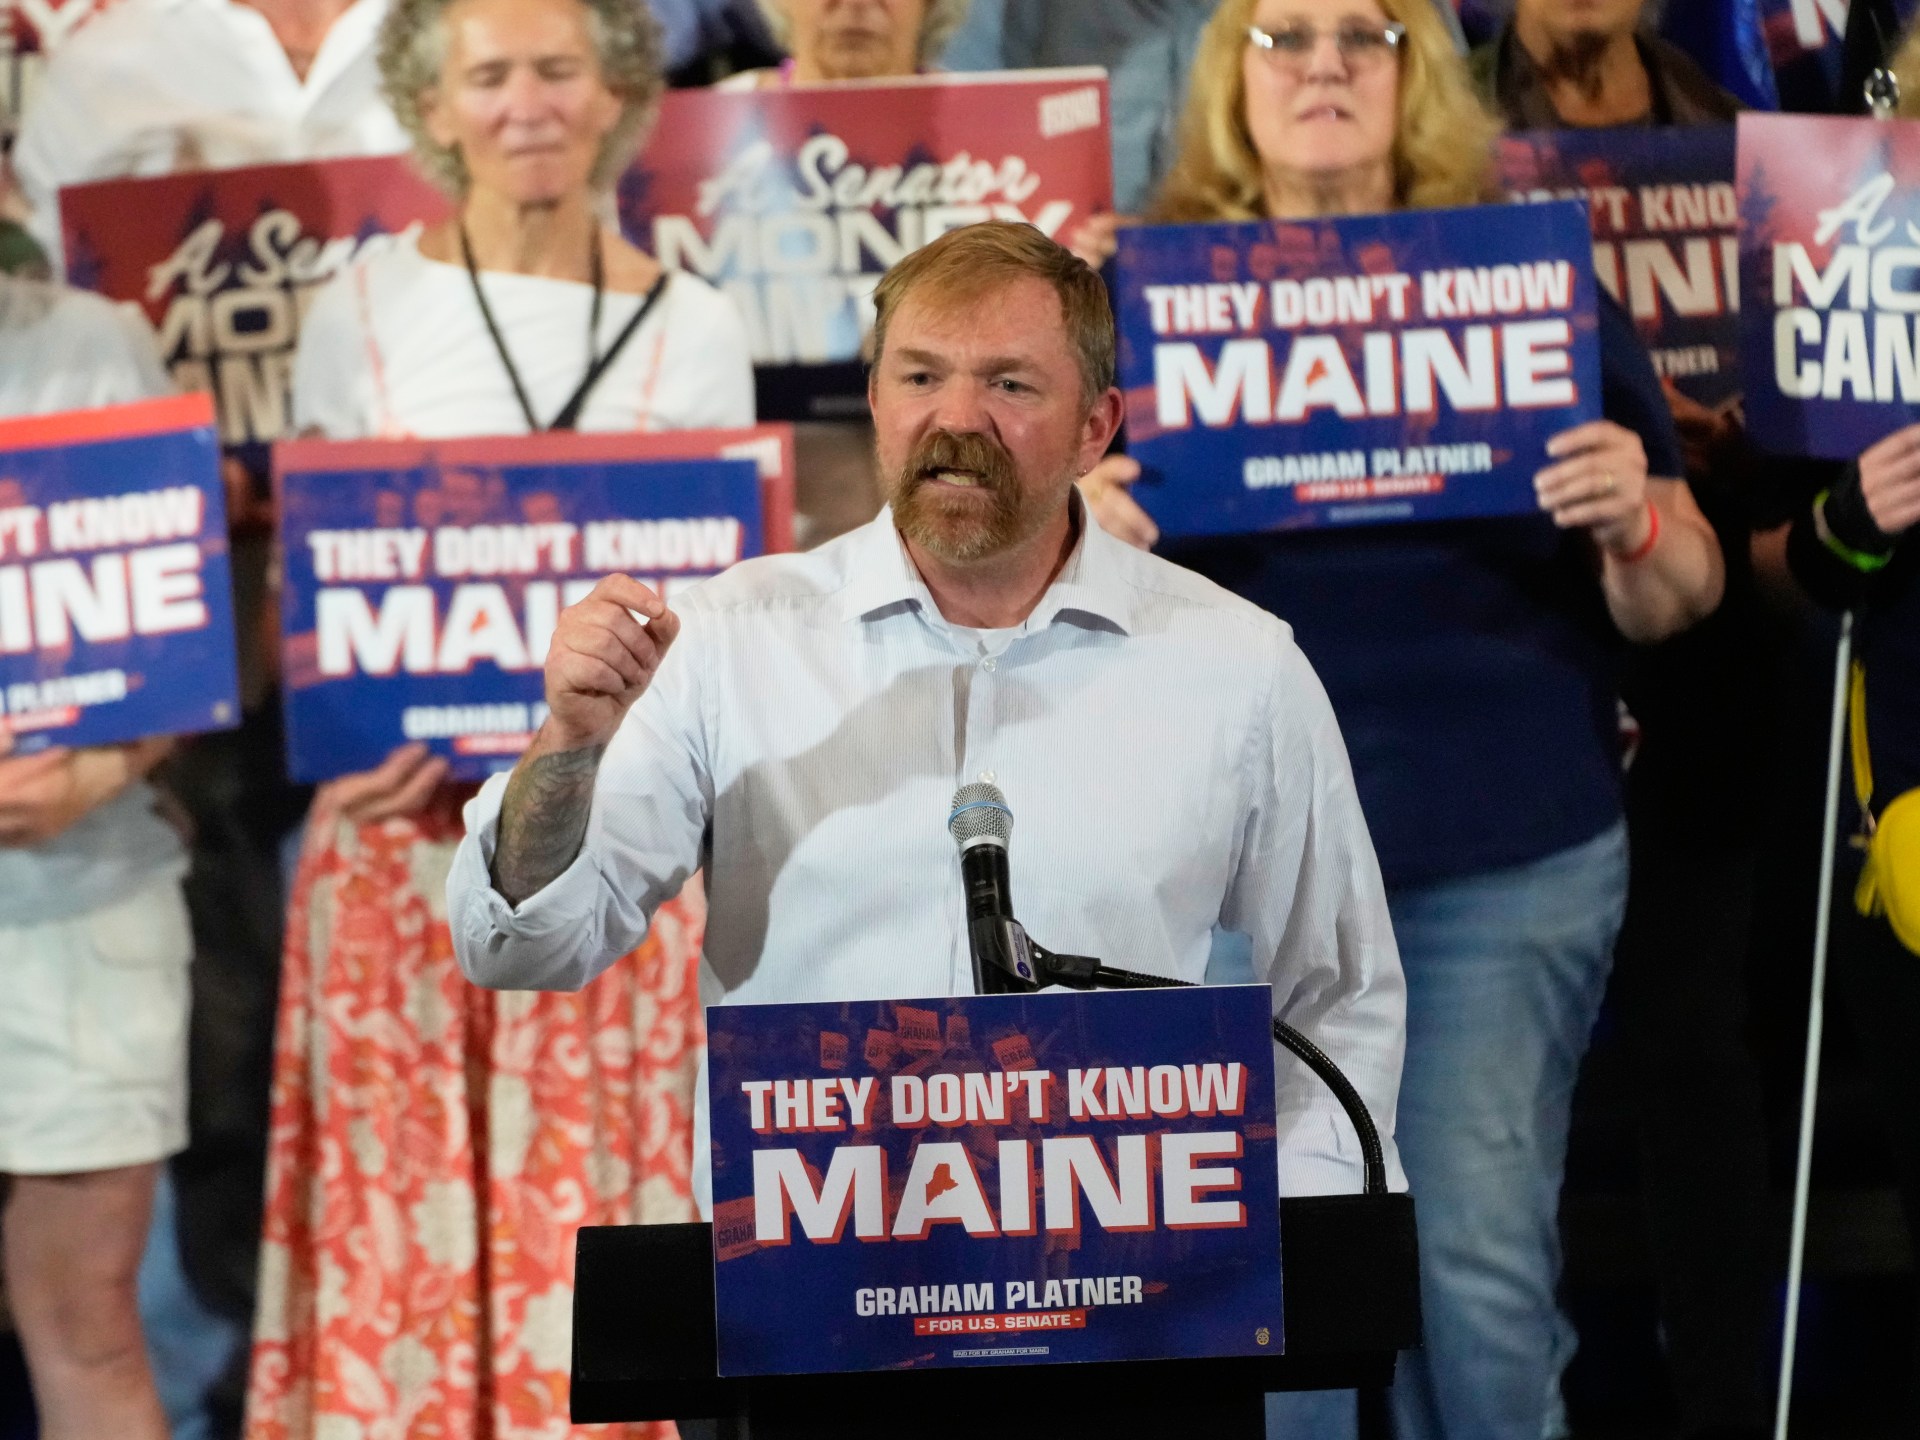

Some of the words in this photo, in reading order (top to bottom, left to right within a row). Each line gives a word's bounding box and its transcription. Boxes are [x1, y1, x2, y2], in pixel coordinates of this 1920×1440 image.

[800, 134, 1041, 212] Senator
[1815, 171, 1895, 246] A
[147, 218, 232, 300] A
[1144, 282, 1261, 335] THEY
[1272, 272, 1410, 328] DON'T
[1421, 260, 1571, 318] KNOW
[1153, 319, 1575, 428] MAINE
[1243, 451, 1366, 489] GRAHAM
[1372, 442, 1492, 476] PLATNER
[49, 485, 202, 552] KNOW
[306, 528, 427, 581] THEY
[434, 521, 577, 577] DON'T
[583, 517, 740, 572] KNOW
[741, 1076, 875, 1131] THEY
[892, 1069, 1050, 1124] DON'T
[1068, 1062, 1241, 1118] KNOW
[752, 1131, 1246, 1241] MAINE
[855, 1282, 994, 1317] GRAHAM
[1006, 1276, 1143, 1310] PLATNER
[929, 1319, 963, 1332] FOR
[969, 1317, 999, 1330] U.S.
[1005, 1314, 1071, 1328] SENATE
